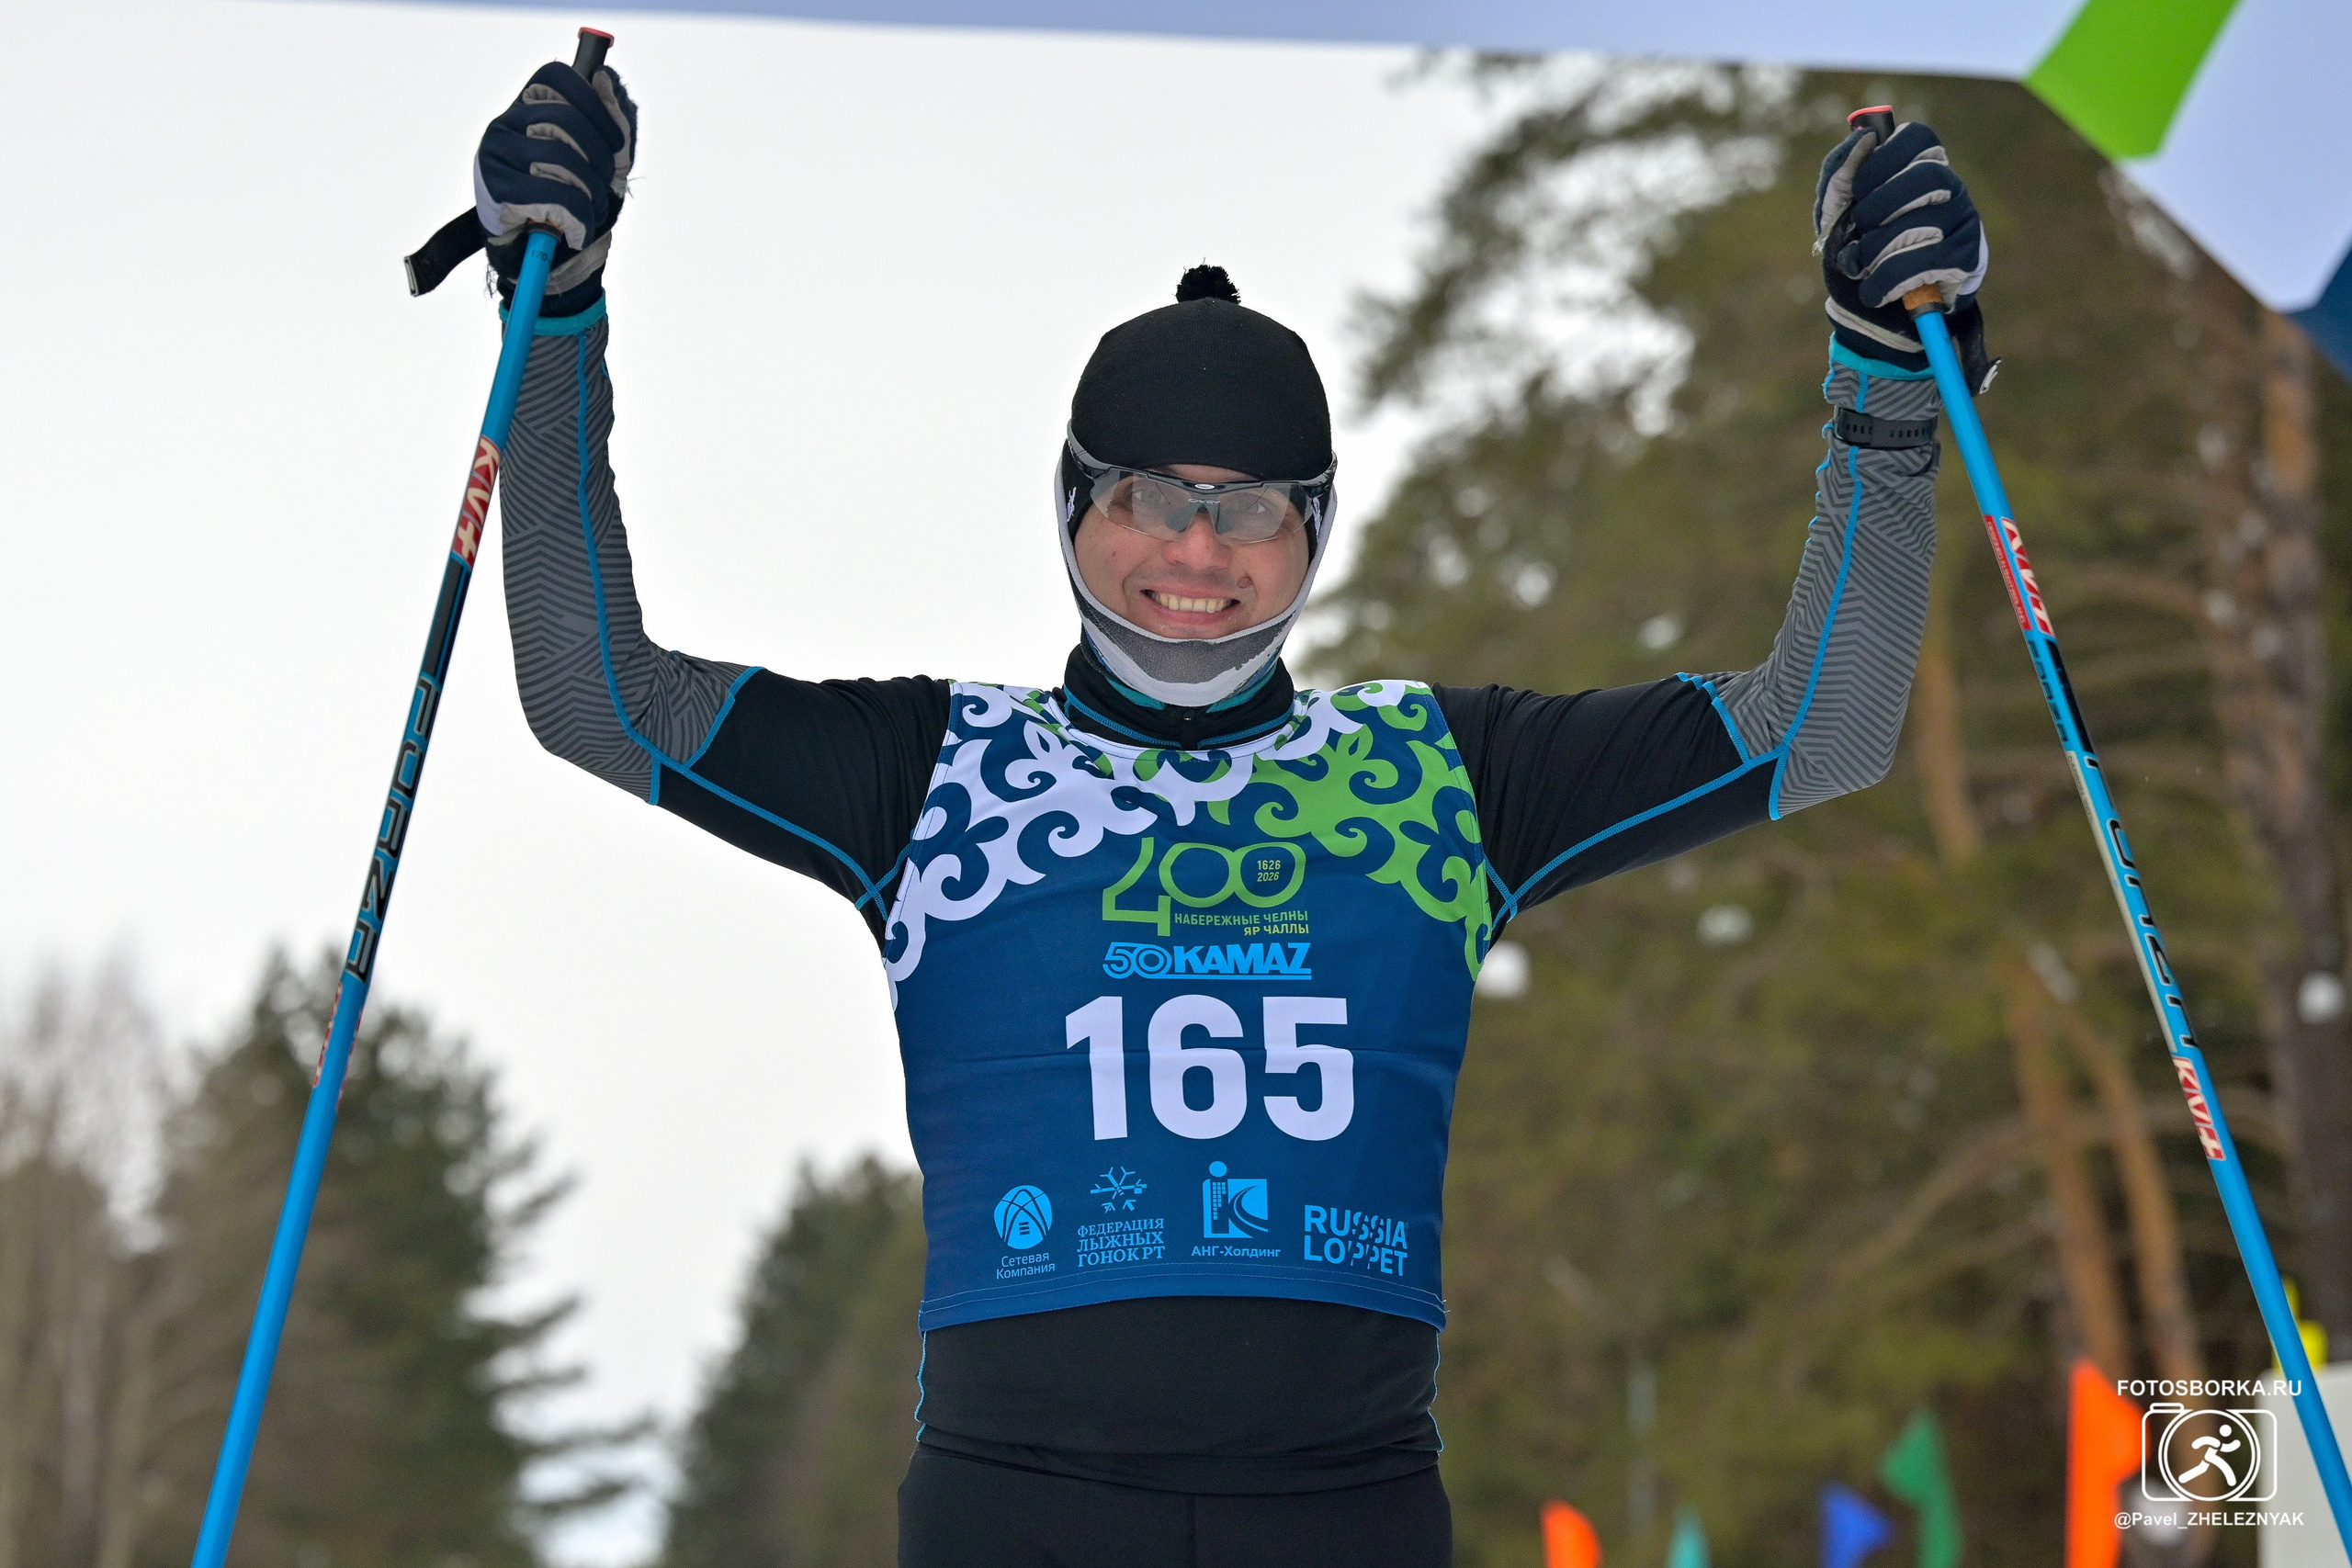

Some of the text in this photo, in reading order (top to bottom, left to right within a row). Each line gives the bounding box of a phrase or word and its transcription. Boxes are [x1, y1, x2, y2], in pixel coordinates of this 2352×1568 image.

[1257, 860, 1281, 871] 1626
[1257, 872, 1280, 883] 2026
[1102, 837, 1306, 937] 400
[1174, 910, 1309, 926] НАБЕРЕЖНЫЕ ЧЕЛНЫ
[1243, 923, 1310, 936] ЯР ЧАЛЛЫ
[1065, 994, 1355, 1141] 165
[1077, 1218, 1164, 1238] ФЕДЕРАЦИЯ
[1304, 1204, 1408, 1250] RUSSIA
[1076, 1231, 1164, 1253] ЛЫЖНЫХ
[1191, 1245, 1281, 1258] АНГ-Холдинг
[1001, 1252, 1050, 1268] Сетевая
[996, 1263, 1056, 1280] Компания
